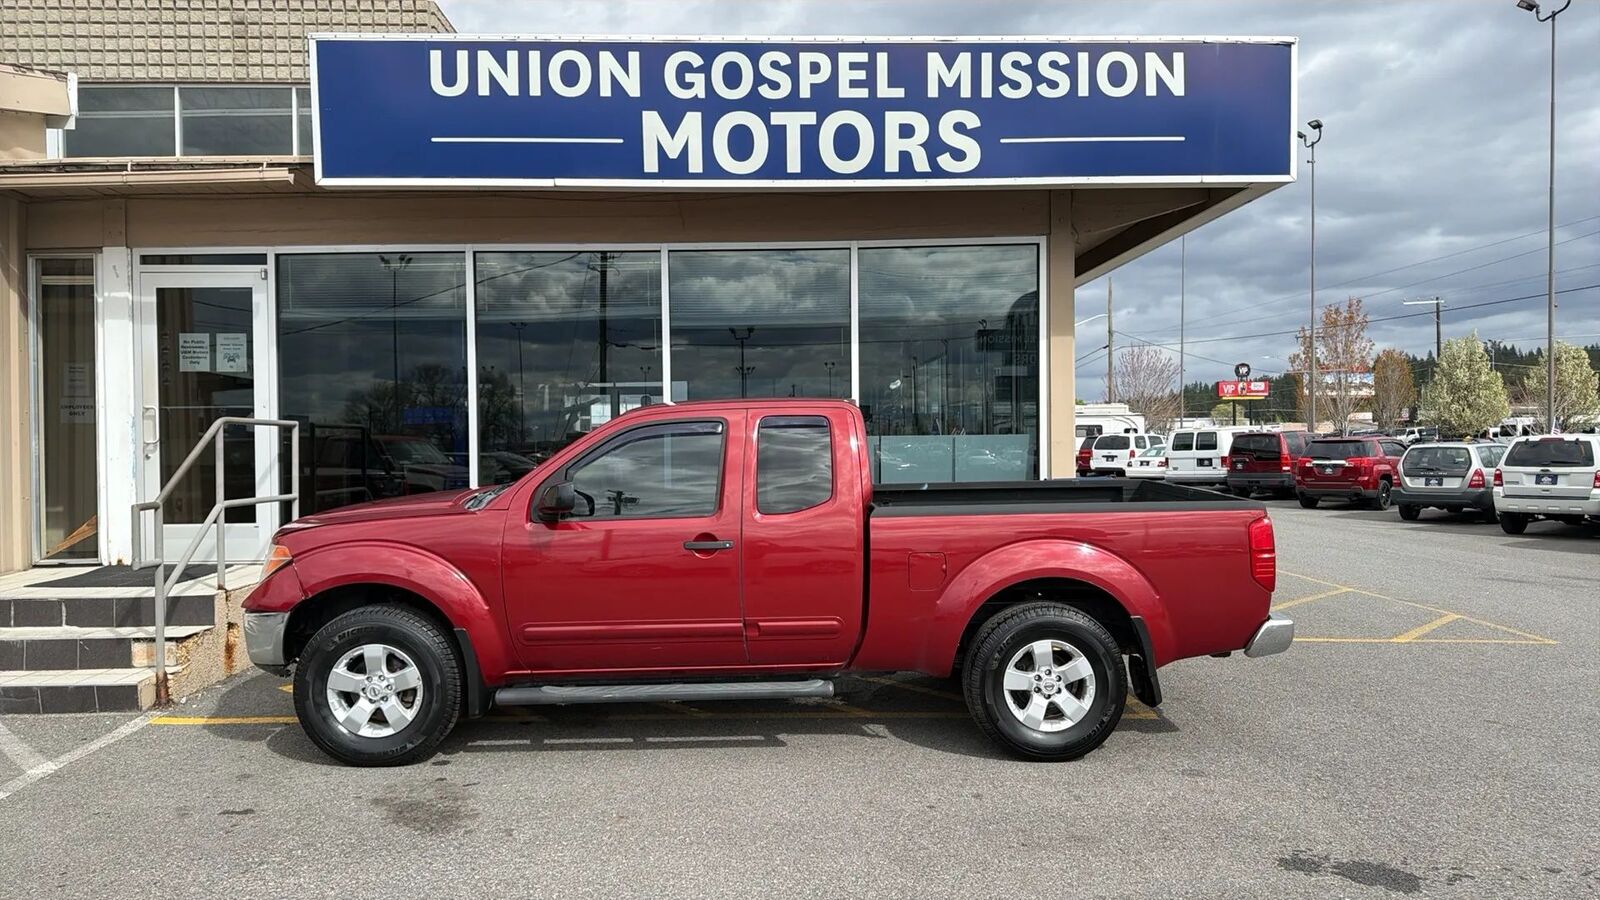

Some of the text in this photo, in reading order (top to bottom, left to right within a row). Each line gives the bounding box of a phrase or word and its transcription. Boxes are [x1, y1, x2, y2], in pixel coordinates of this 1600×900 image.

[430, 49, 1185, 100] UNION GOSPEL MISSION
[642, 109, 981, 175] MOTORS
[1222, 384, 1236, 394] VIP
